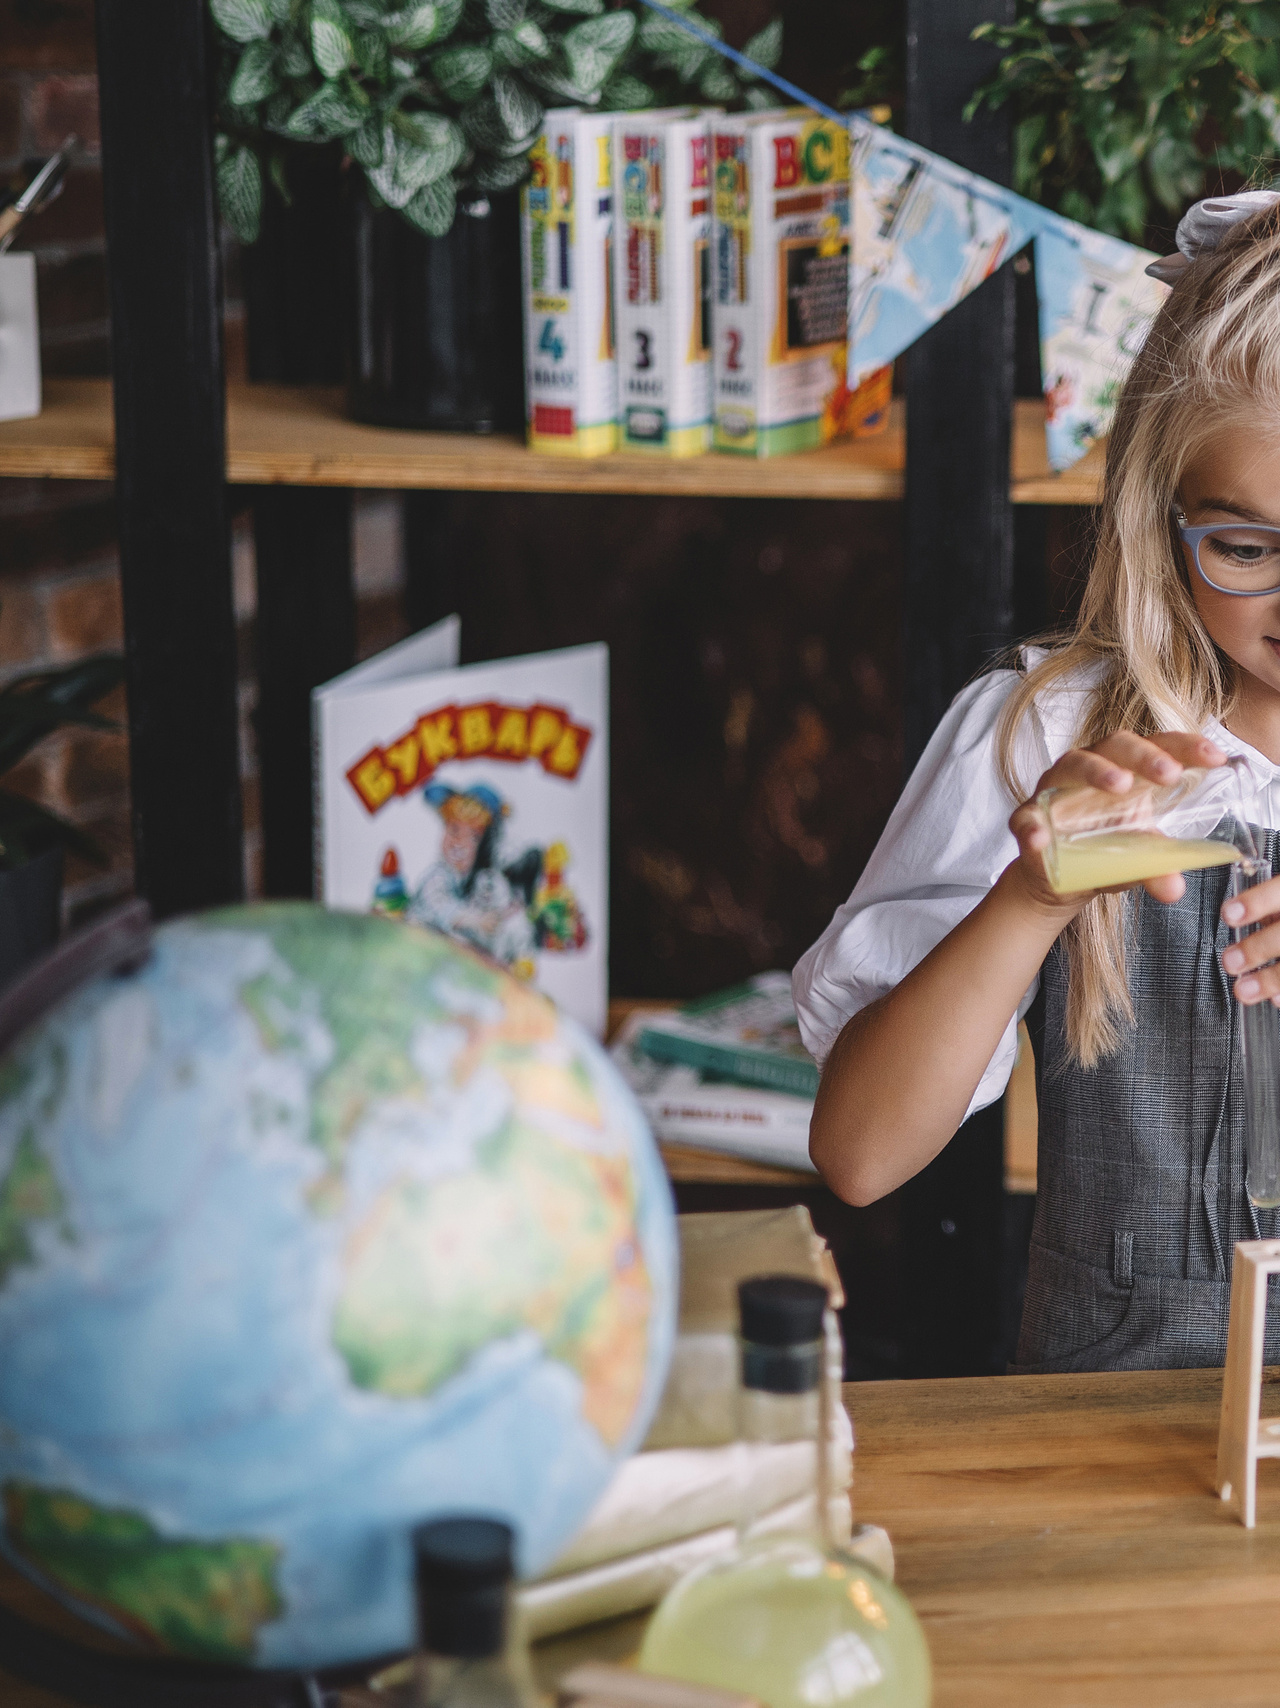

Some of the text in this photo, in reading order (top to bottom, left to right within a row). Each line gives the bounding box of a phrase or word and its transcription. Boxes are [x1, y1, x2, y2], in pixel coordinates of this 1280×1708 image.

[819, 216, 842, 257] 2
[538, 319, 565, 362] 4
[634, 330, 652, 370] 3
[725, 330, 743, 371] 2
[355, 706, 582, 805] БУКВАРЬ
